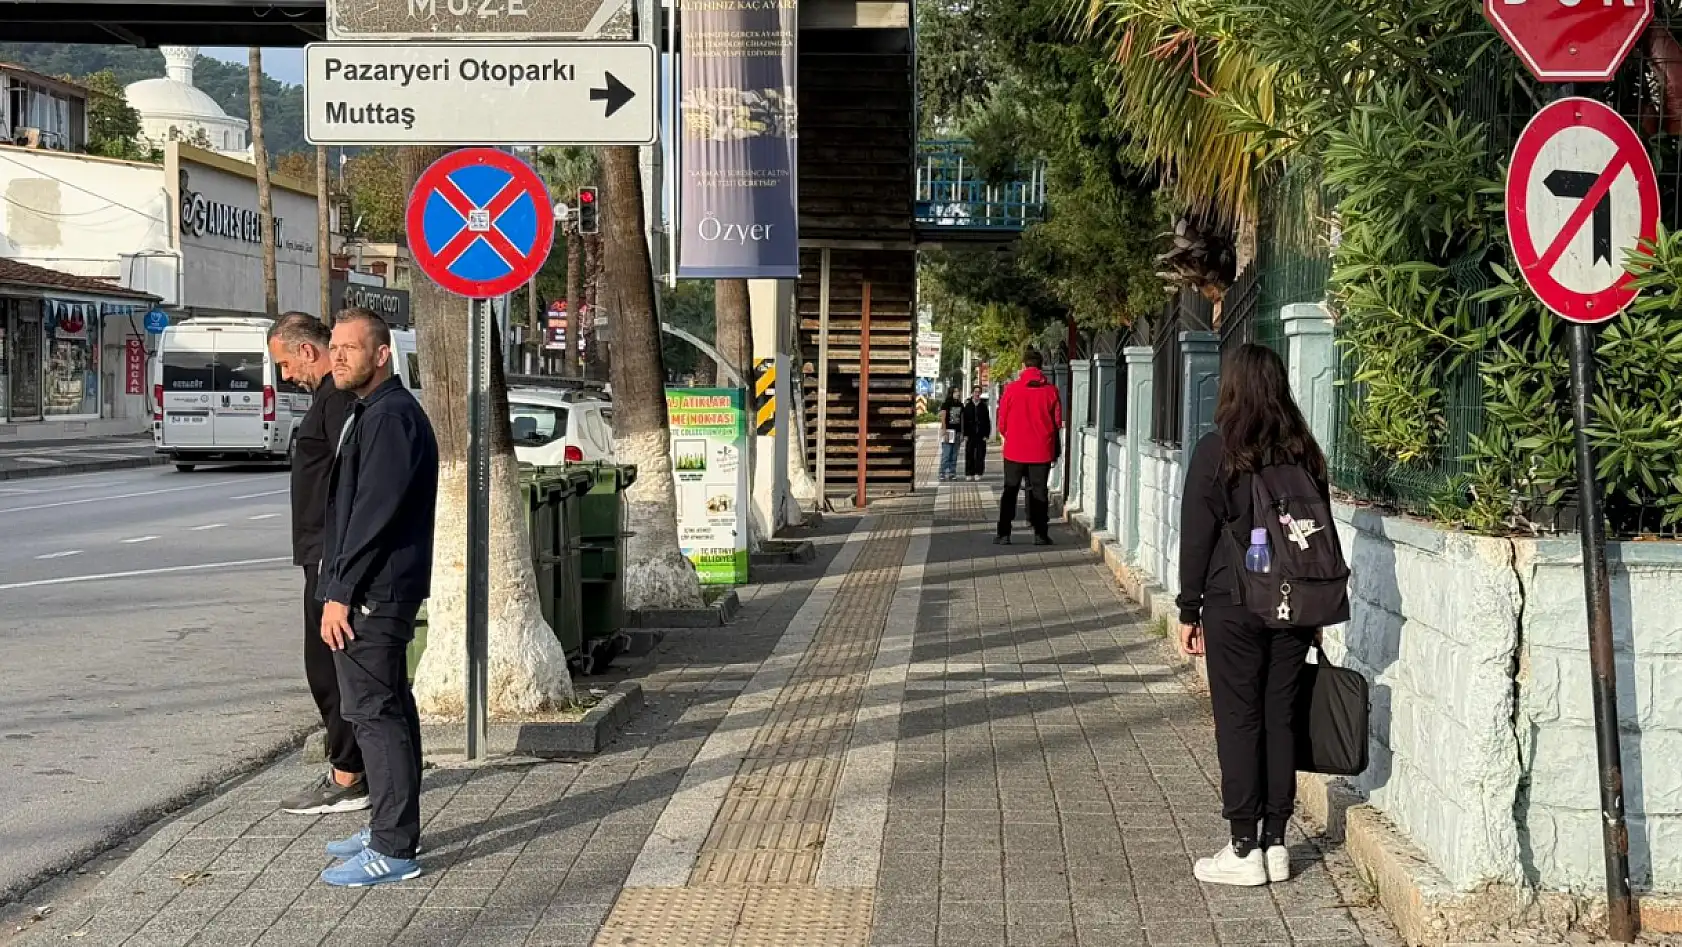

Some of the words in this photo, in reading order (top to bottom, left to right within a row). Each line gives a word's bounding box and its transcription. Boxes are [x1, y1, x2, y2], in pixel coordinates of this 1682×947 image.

[737, 0, 762, 11] KAÇ
[325, 58, 450, 87] Pazaryeri
[459, 58, 576, 87] Otoparkı
[325, 101, 416, 130] Muttaş
[206, 200, 241, 240] ADRES
[698, 210, 774, 246] Özyer
[130, 340, 141, 393] OYUNCAK
[682, 396, 731, 408] ATIKLARI
[689, 413, 735, 425] NOKTASI
